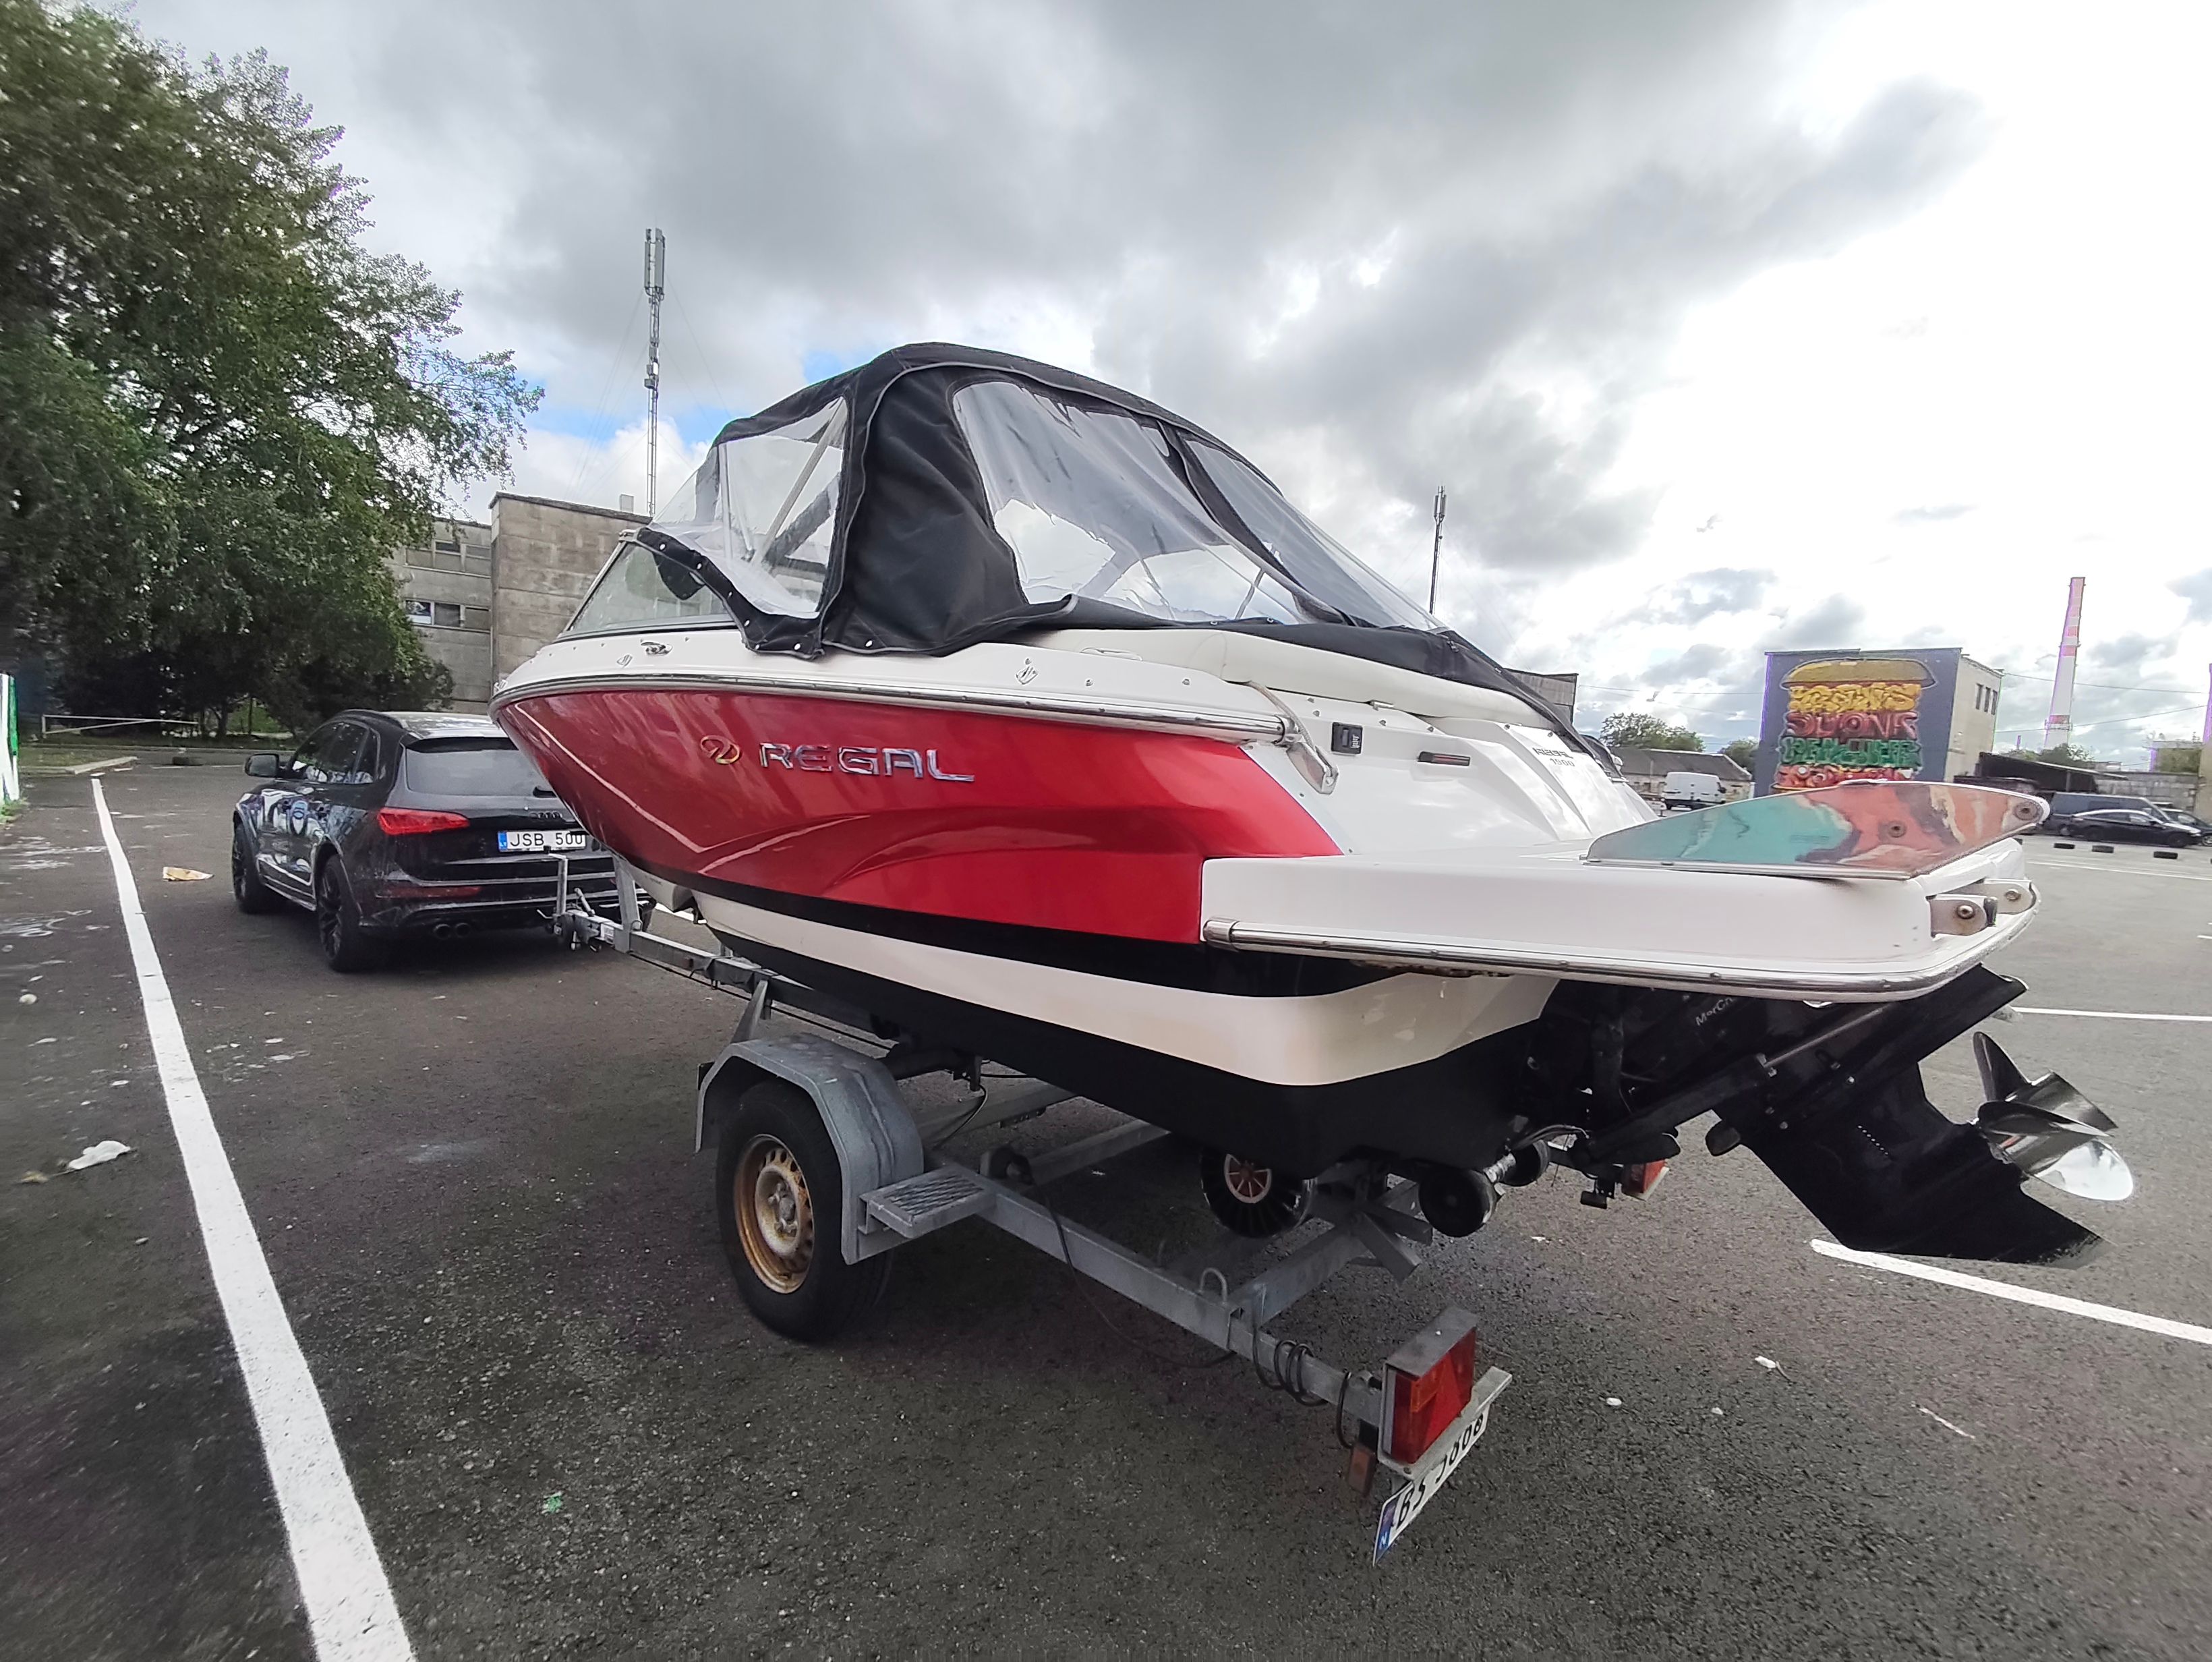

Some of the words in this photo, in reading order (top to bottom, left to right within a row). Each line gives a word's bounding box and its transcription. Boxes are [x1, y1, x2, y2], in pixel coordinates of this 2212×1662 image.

[759, 743, 975, 782] REGAL
[1549, 757, 1575, 767] 1900
[510, 832, 544, 847] JSB
